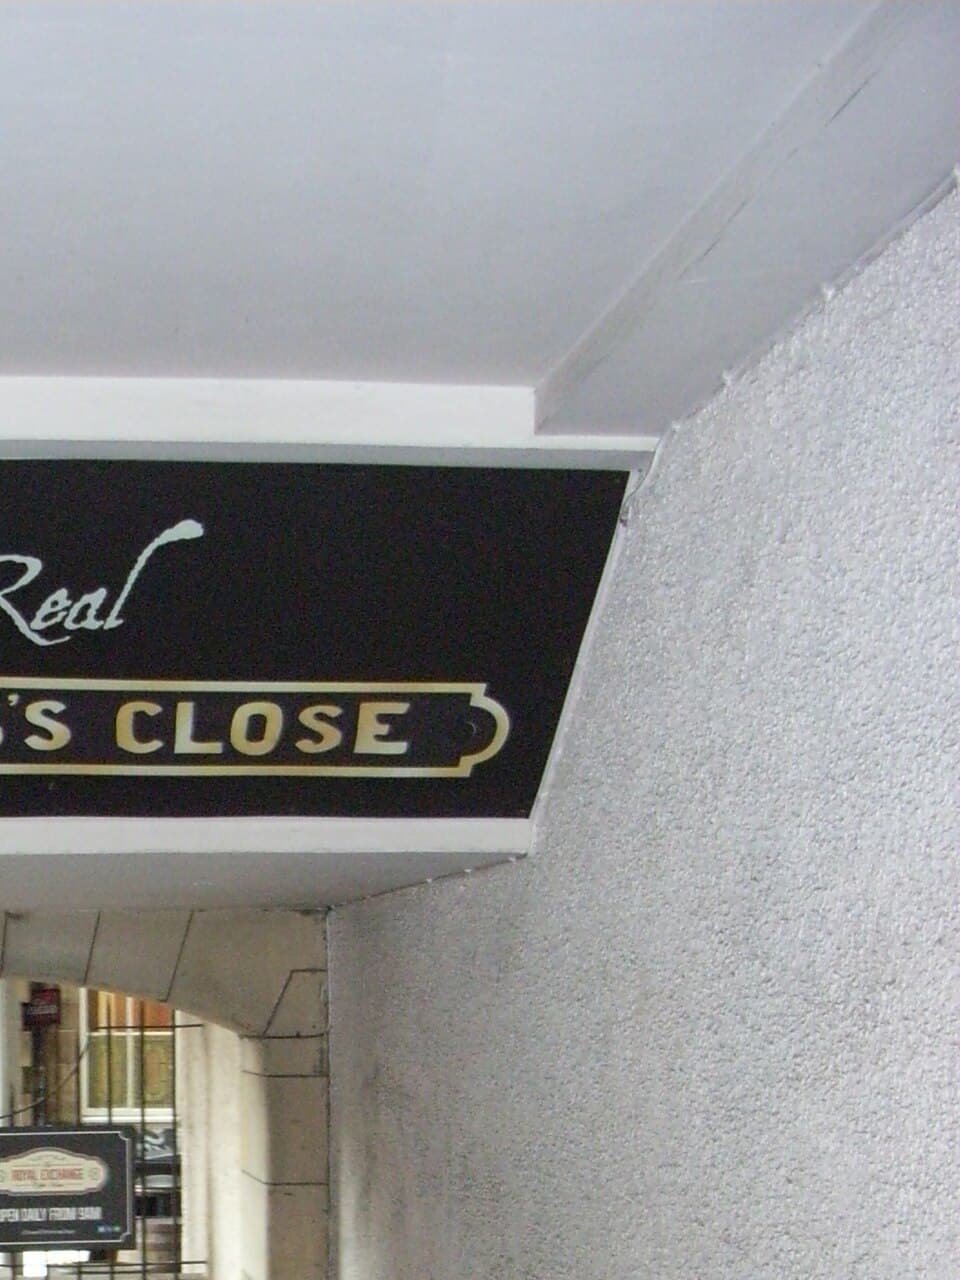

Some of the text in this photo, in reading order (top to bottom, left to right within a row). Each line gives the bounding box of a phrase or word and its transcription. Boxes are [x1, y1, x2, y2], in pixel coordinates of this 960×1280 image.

[115, 701, 410, 756] CLOSE
[11, 1168, 83, 1181] ROYAL EXCHANGE
[21, 1207, 47, 1221] DAILY
[48, 1207, 76, 1221] FROM
